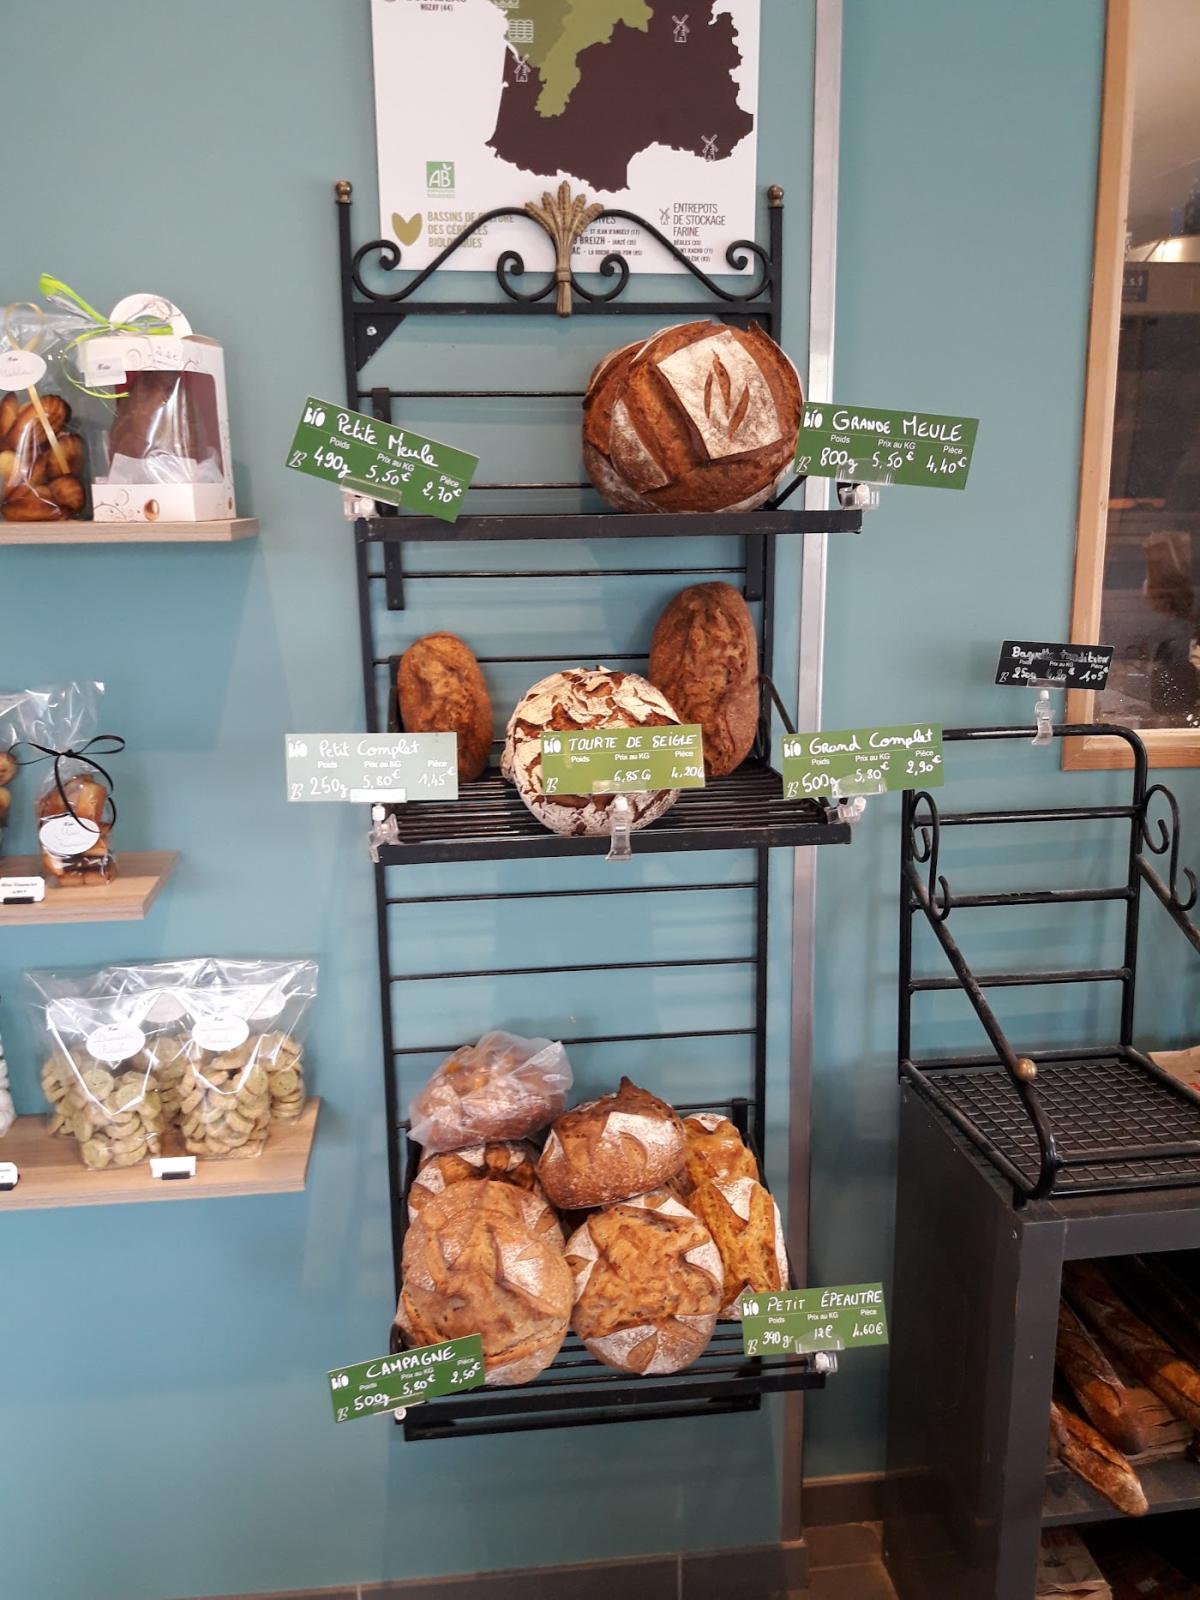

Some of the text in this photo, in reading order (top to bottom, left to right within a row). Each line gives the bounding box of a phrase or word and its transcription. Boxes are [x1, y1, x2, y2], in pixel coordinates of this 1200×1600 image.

[427, 212, 463, 222] BASSINS
[465, 212, 475, 222] DE
[673, 215, 726, 225] DE STOCKAGE
[428, 225, 444, 235] DES
[673, 227, 700, 236] FARINE
[902, 415, 962, 442] MEULE
[336, 413, 378, 445] Petite
[388, 432, 438, 467] Meule
[830, 434, 850, 444] Poids
[877, 439, 892, 447] Prix
[903, 441, 916, 450] KG
[943, 445, 963, 455] Pièce
[313, 446, 351, 478] 490g
[329, 436, 459, 488] Poids Prix au KG Pièce
[820, 447, 859, 474] 800g
[319, 739, 350, 758] Petit
[357, 739, 420, 759] Complet
[568, 737, 618, 751] TOURTE
[625, 736, 643, 748] DE
[809, 734, 862, 755] Grand
[869, 728, 933, 748] Complet
[427, 760, 448, 768] Pièce
[639, 752, 650, 760] KG
[674, 750, 694, 758] Pièce
[811, 749, 934, 766] Poids Prix au KG Pièce
[310, 776, 349, 798] 250g
[821, 1290, 883, 1308] ÉPEAUTRE
[807, 1313, 819, 1321] Prix
[828, 1311, 839, 1319] KG
[860, 1308, 877, 1316] Pièce
[366, 1345, 456, 1378] CAMPAGNE
[359, 1382, 377, 1391] Poids
[457, 1357, 476, 1366] Pièce
[354, 1393, 390, 1411] 500g
